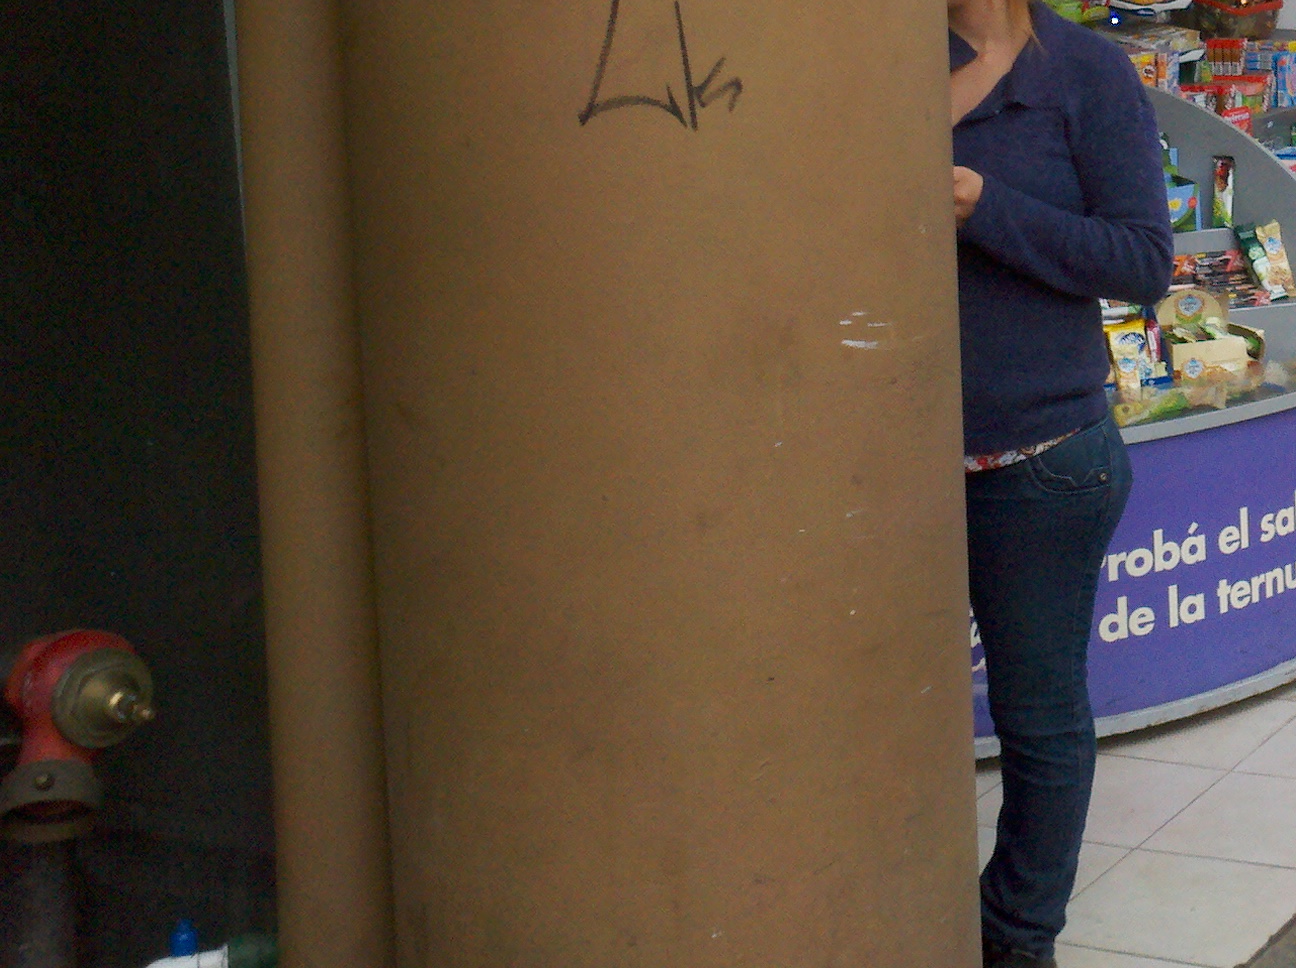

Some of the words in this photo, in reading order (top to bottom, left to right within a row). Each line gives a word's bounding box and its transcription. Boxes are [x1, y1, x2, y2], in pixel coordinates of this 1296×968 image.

[1101, 521, 1207, 582] robá
[1218, 506, 1249, 555] el
[1098, 596, 1155, 643] de
[1168, 584, 1206, 628] la
